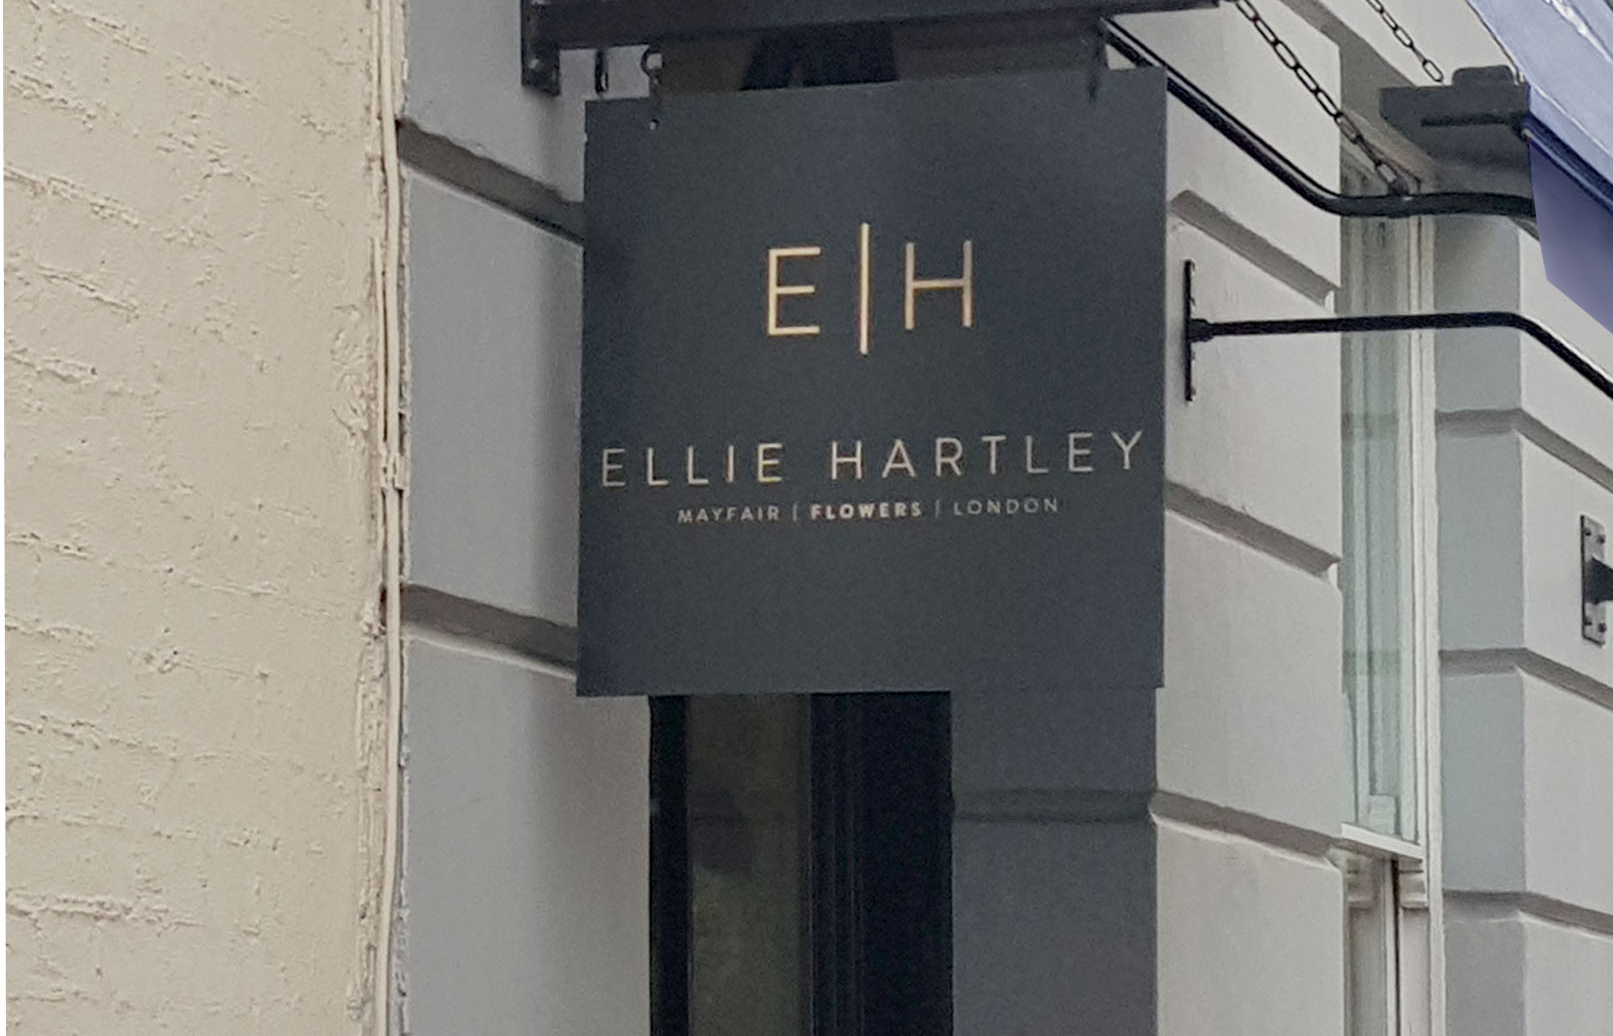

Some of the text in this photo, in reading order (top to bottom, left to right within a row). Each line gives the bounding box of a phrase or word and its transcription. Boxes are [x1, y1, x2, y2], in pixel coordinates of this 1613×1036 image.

[603, 431, 1143, 487] ELLIE HARTLEY
[677, 498, 1058, 523] MAYFAIR FLOWERS LONDON
